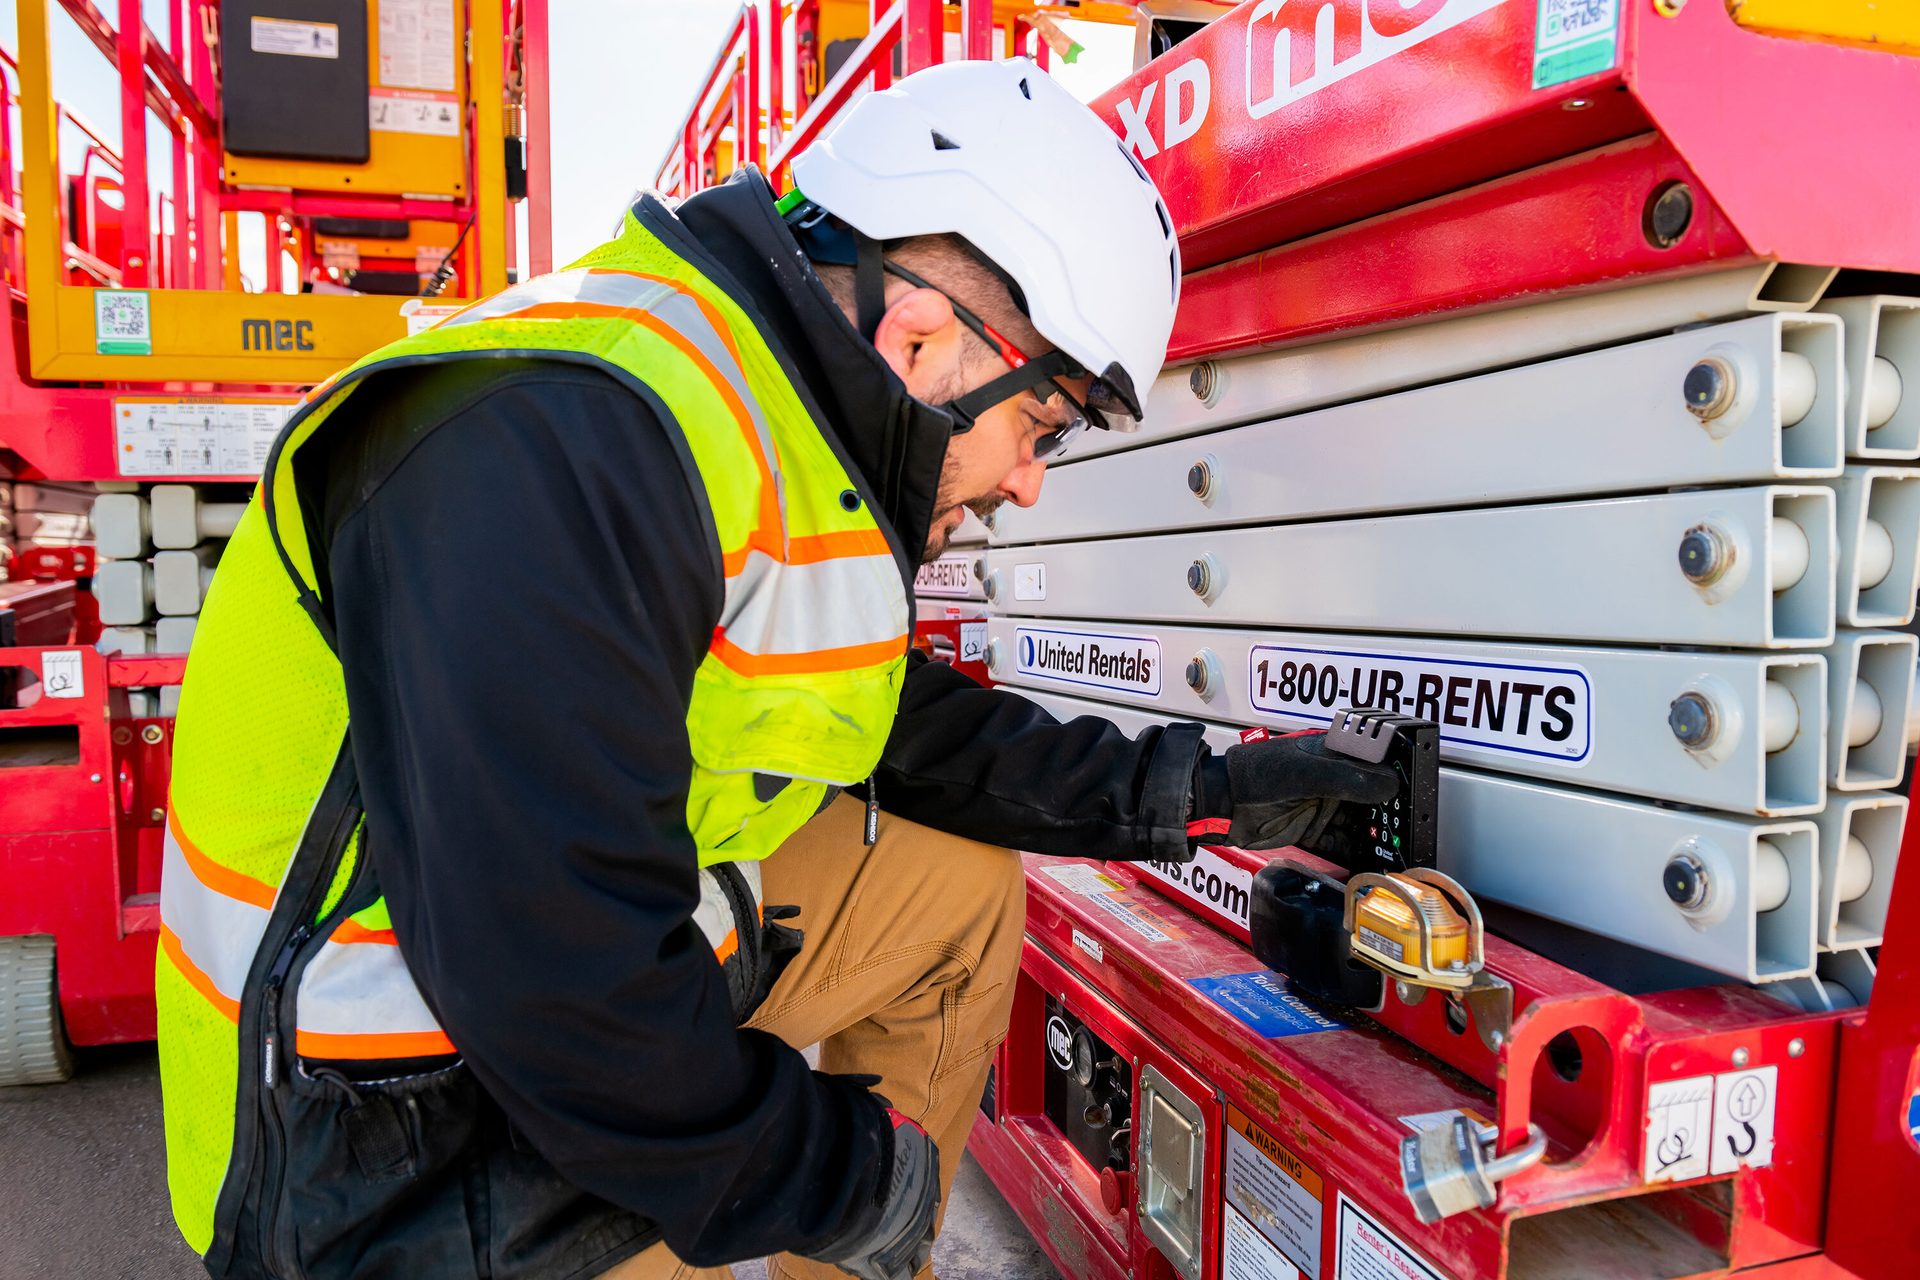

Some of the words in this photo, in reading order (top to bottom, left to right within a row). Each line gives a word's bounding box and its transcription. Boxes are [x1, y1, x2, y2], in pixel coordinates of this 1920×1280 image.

[1116, 57, 1211, 161] XD
[242, 319, 314, 351] mec
[1037, 639, 1084, 675] United
[1088, 644, 1151, 683] Rentals
[1256, 658, 1577, 743] 1-800-UR-RENTS
[1382, 813, 1388, 824] 8
[1393, 816, 1400, 829] 9
[1394, 798, 1400, 810] 6
[1381, 830, 1388, 842] 0
[1249, 974, 1285, 995] Total
[1280, 994, 1340, 1028] Control
[1050, 1024, 1071, 1062] mec
[1255, 1128, 1302, 1180] WARNING
[1356, 1221, 1392, 1259] Renter's
